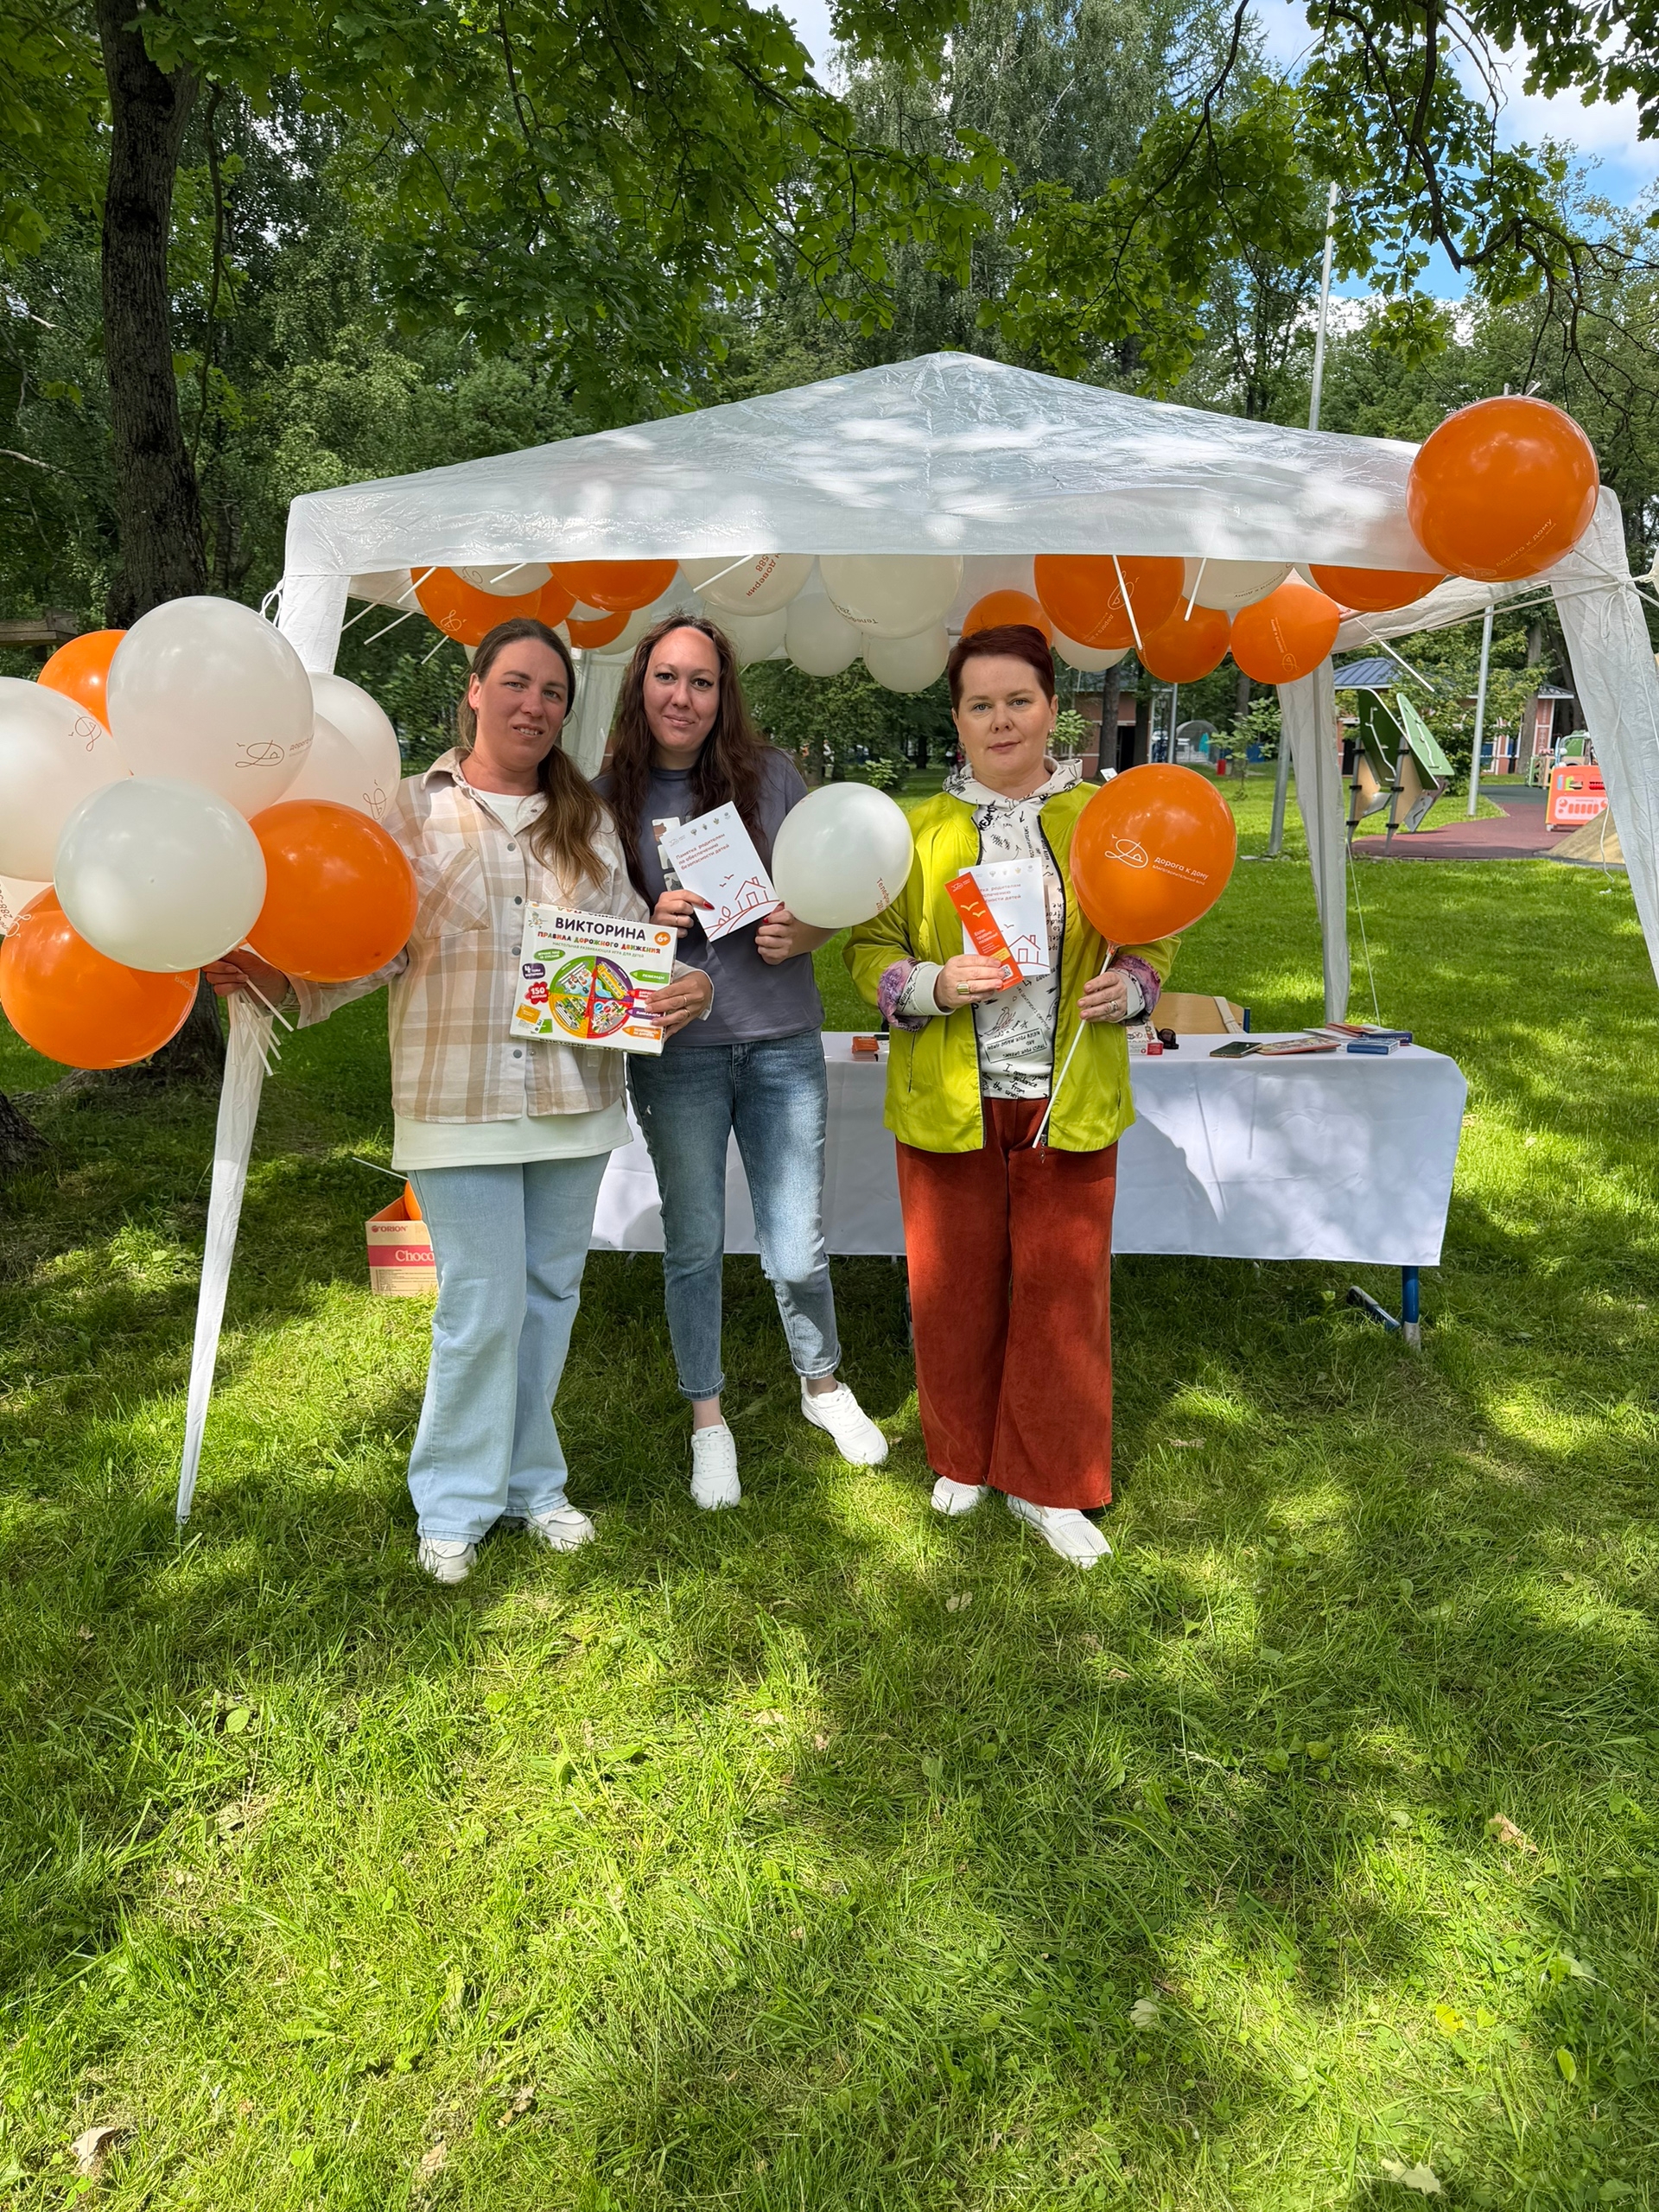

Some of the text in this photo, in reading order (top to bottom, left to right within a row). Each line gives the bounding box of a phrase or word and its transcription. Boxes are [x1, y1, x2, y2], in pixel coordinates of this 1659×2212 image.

[746, 559, 777, 597] доверия
[676, 847, 697, 860] Памятка
[698, 833, 726, 849] родителям
[681, 843, 730, 871] безопасности детей
[686, 842, 719, 861] обеспечению
[1154, 856, 1185, 871] дорога
[1191, 869, 1209, 880] дому
[555, 917, 646, 941] ВИКТОРИНА
[657, 934, 669, 943] 6+
[537, 931, 661, 955] ПРАВИЛА ДОРОЖНОГО ДВИЖЕНИЯ
[993, 1081, 1002, 1091] the
[1009, 1076, 1038, 1088] guidance
[1011, 1082, 1025, 1093] from
[395, 1249, 435, 1262] Choco
